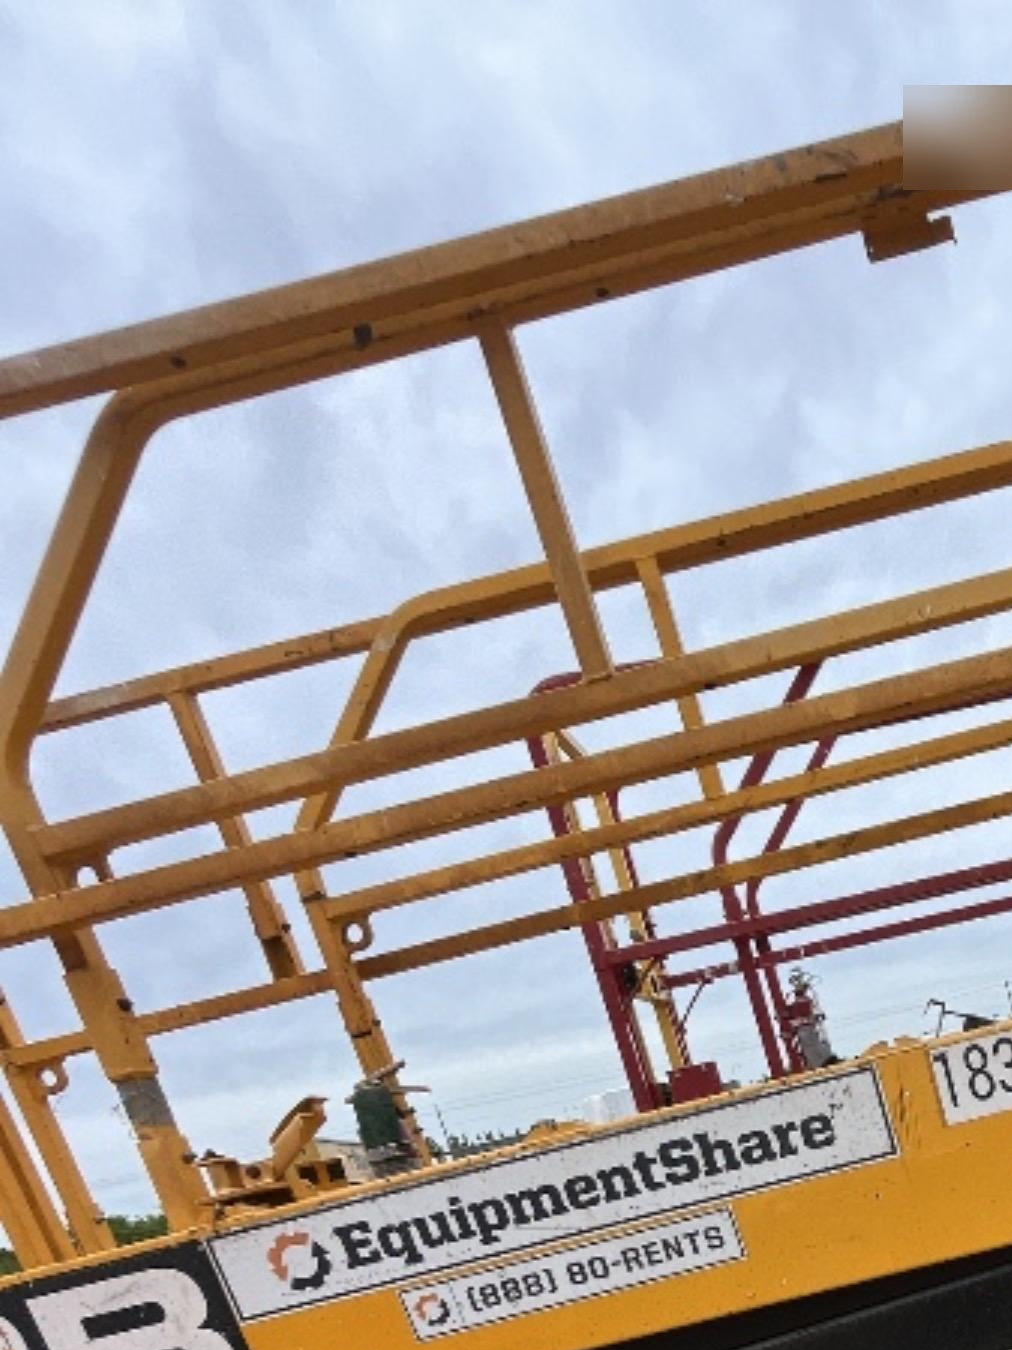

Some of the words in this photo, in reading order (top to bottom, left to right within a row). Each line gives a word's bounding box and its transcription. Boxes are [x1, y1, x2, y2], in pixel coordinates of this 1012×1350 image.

[332, 1112, 836, 1270] EquipmentShare
[466, 1269, 557, 1312] (888)
[565, 1225, 725, 1285] 80-RENTS
